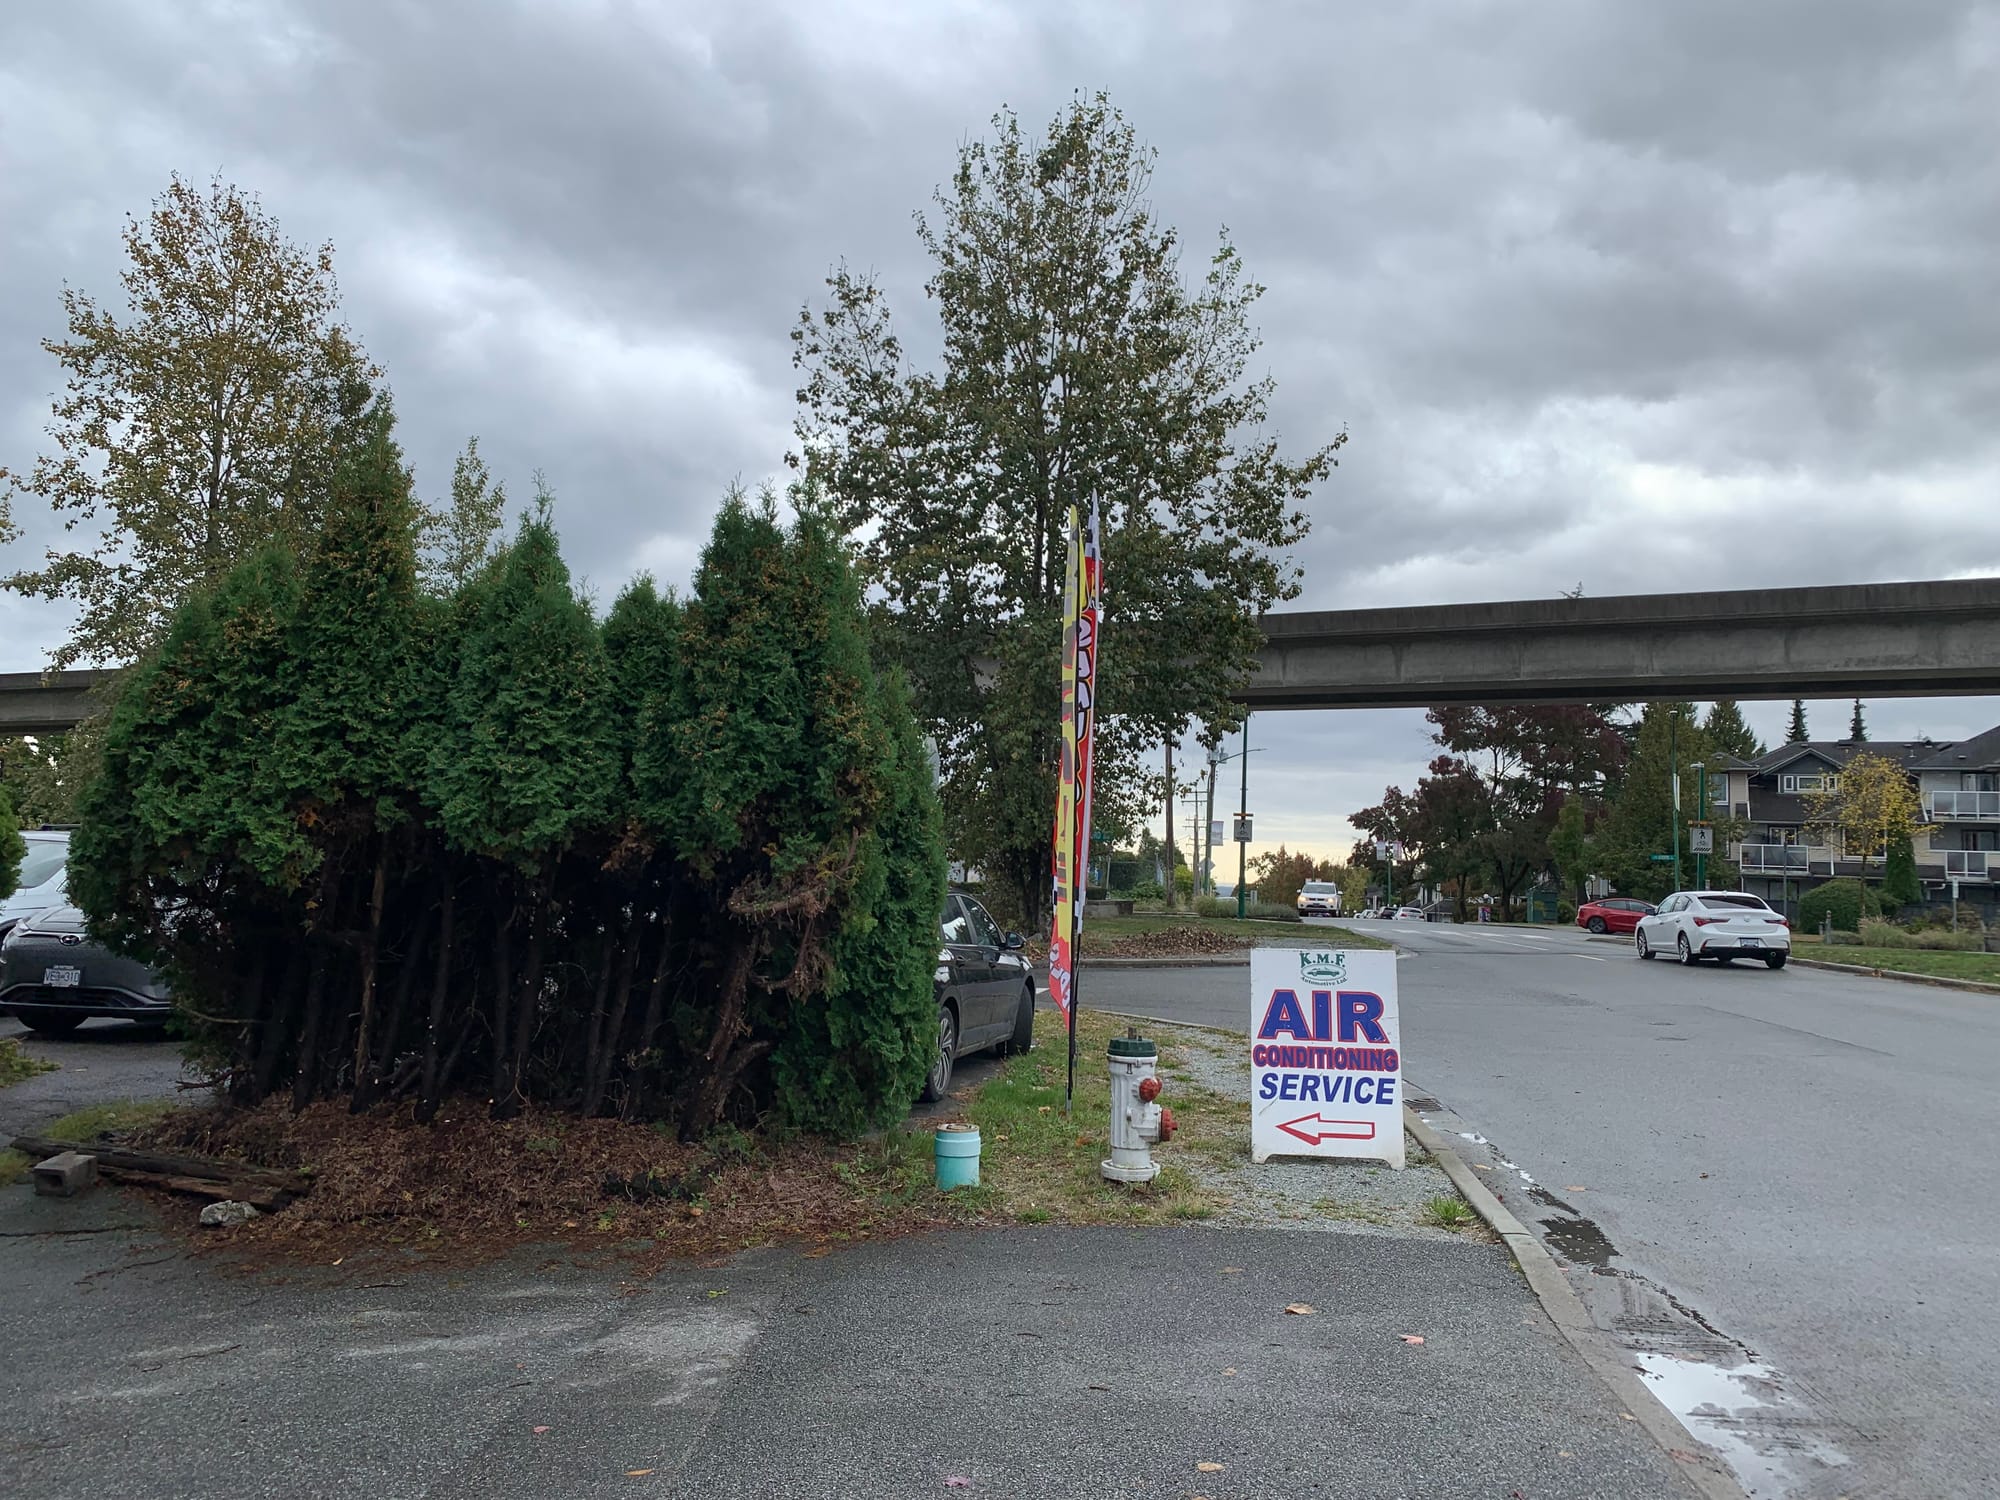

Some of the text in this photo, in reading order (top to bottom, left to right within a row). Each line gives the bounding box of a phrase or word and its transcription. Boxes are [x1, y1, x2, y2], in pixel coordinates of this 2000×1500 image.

[1301, 977, 1335, 987] Automotive
[1257, 988, 1390, 1044] AIR
[1253, 1044, 1399, 1072] CONDITIONING
[1259, 1073, 1396, 1105] SERVICE
